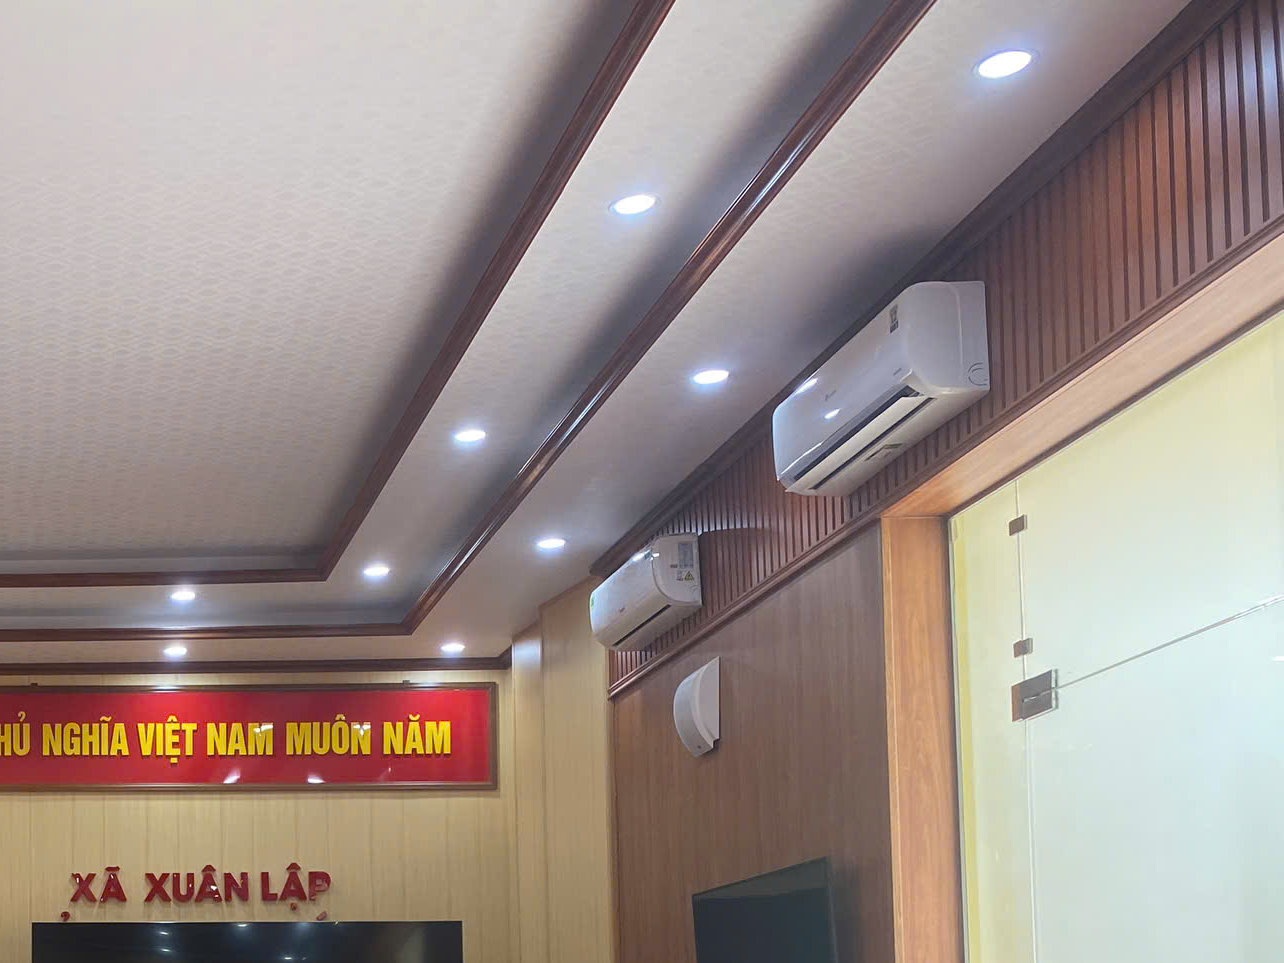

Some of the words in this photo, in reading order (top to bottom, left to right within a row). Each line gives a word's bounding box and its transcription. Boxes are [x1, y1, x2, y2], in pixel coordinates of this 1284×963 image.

[42, 715, 129, 756] NGHĨA
[137, 715, 198, 763] VIỆT
[206, 722, 273, 756] NAM
[286, 714, 371, 756] MUÔN
[382, 714, 451, 755] NĂM
[70, 866, 127, 902] XÃ
[144, 864, 249, 902] XUÂN
[261, 862, 332, 910] LẬP
